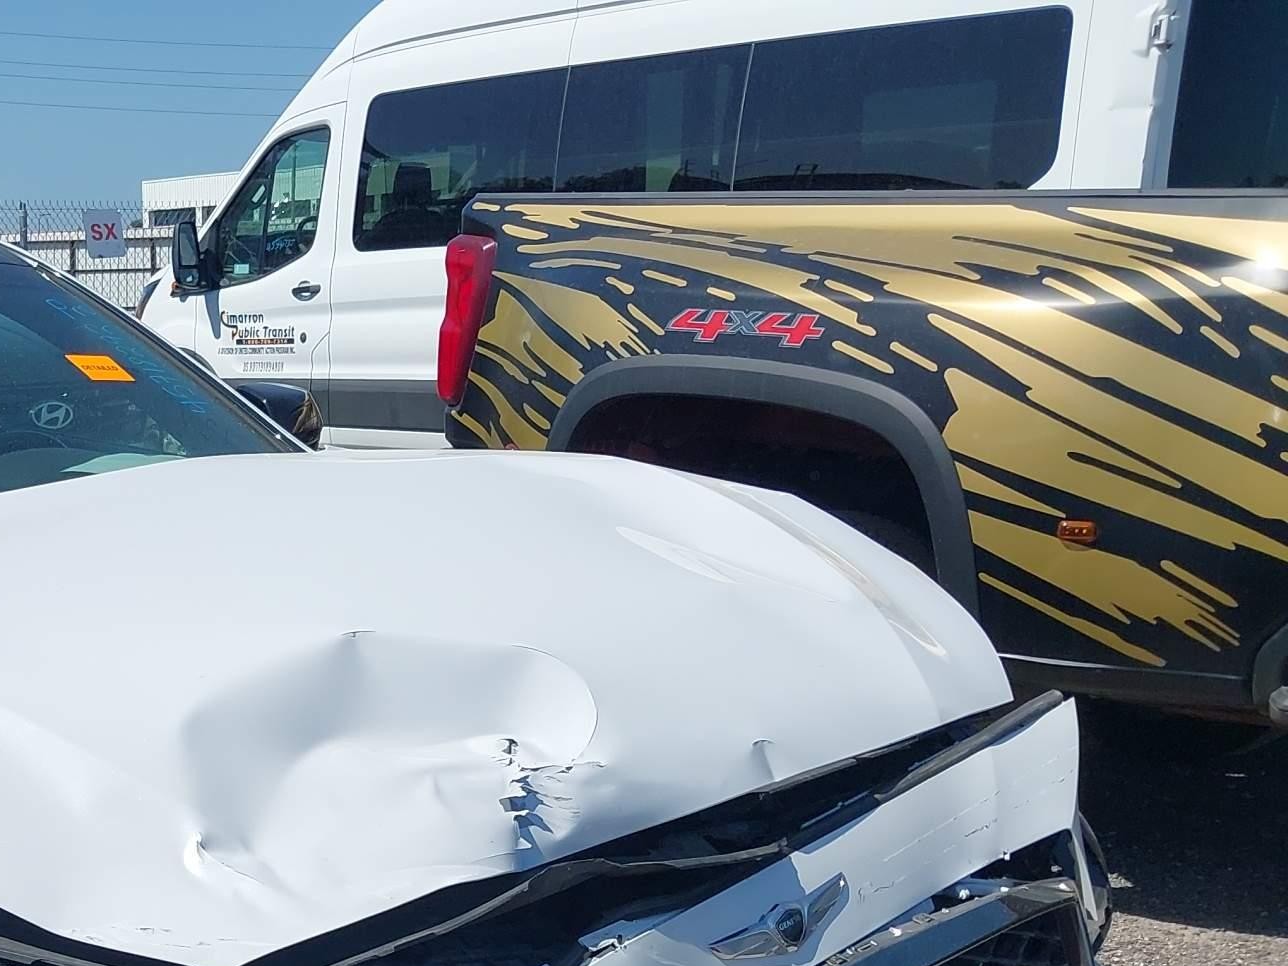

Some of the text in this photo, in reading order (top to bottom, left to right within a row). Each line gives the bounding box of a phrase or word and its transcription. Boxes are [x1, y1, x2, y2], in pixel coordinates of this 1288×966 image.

[91, 223, 118, 241] SX
[220, 310, 264, 328] Cimarron
[232, 325, 295, 340] Public Transit
